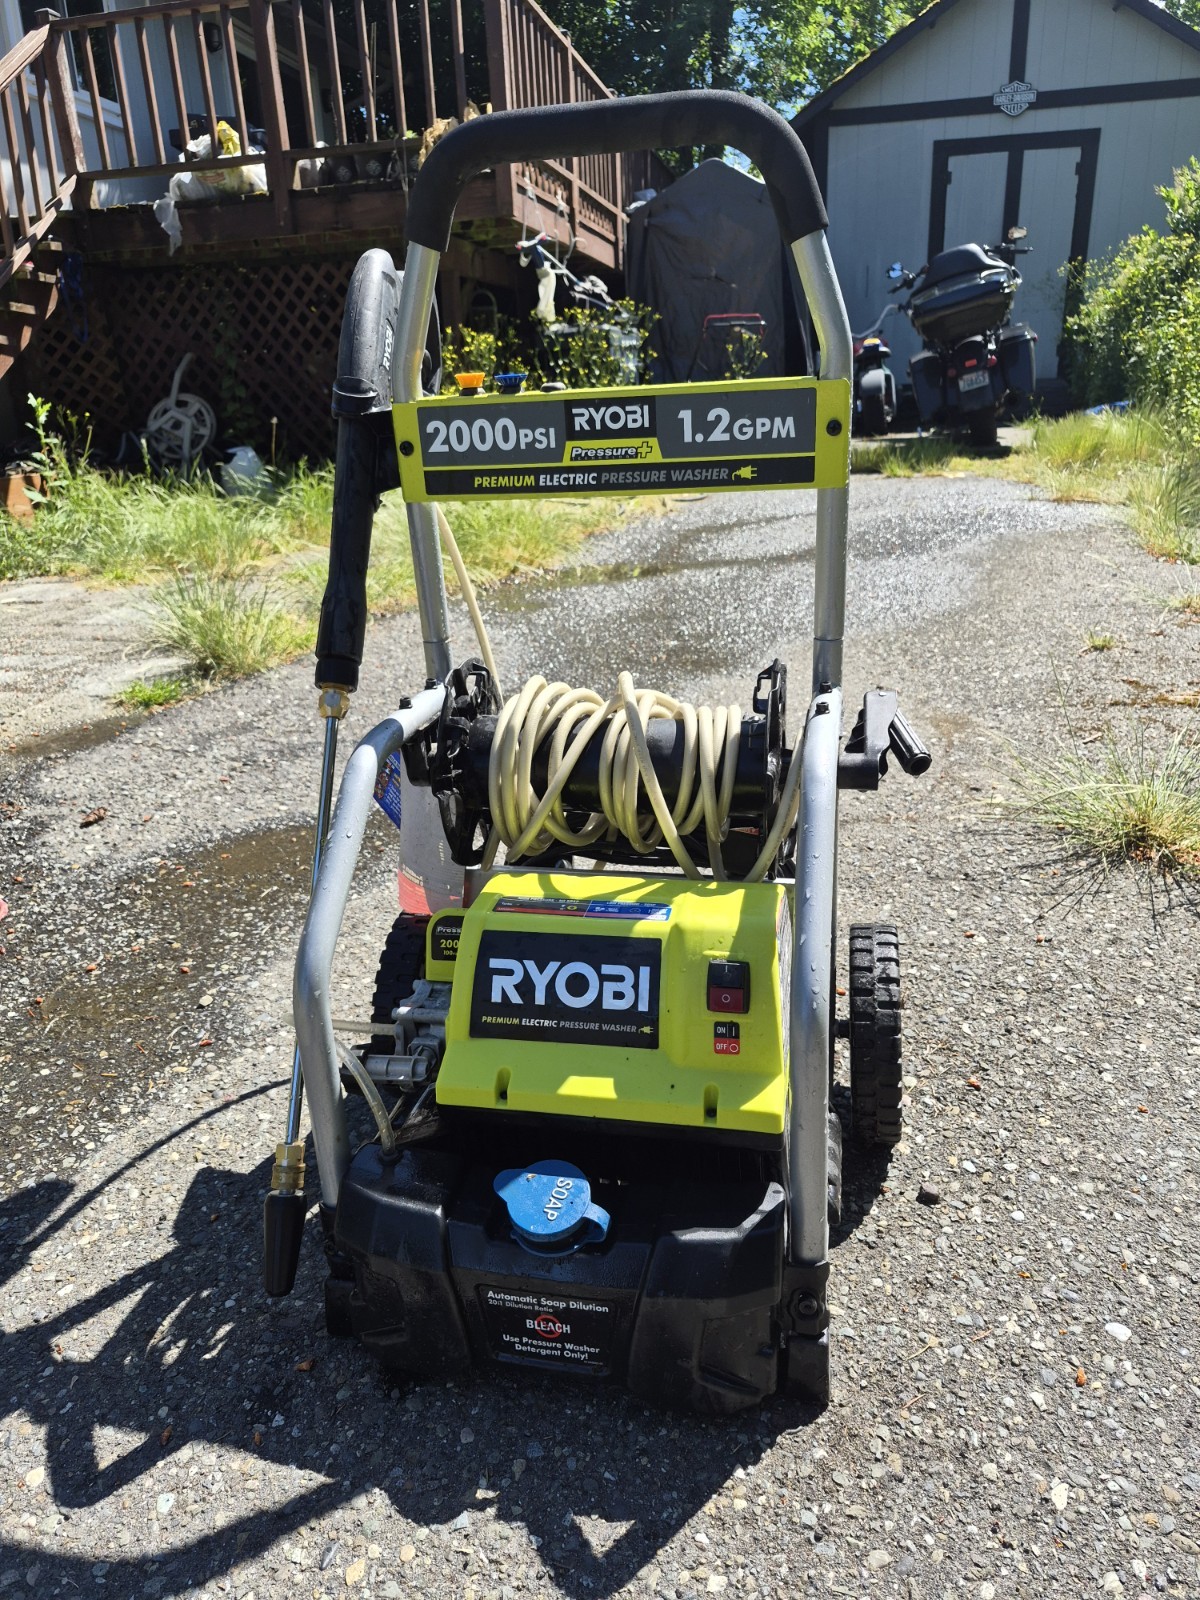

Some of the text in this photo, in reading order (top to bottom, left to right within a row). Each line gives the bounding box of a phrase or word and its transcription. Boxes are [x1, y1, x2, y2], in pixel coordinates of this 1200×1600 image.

[382, 325, 393, 371] RYOBI
[572, 405, 649, 431] RYOBI
[474, 468, 729, 488] PREMIUM ELECTRIC PRESSURE WASHER
[489, 957, 651, 1012] RYOBI
[481, 1015, 637, 1033] PREMIUM ELECTRIC PRESSURE WASHER
[716, 1026, 726, 1034] ON
[543, 1177, 573, 1221] SOAP
[487, 1290, 609, 1313] Automatic Soap Dilution
[505, 1301, 532, 1310] Dilution
[534, 1305, 553, 1313] Ratio
[526, 1319, 571, 1334] BLEACH
[503, 1334, 600, 1354] Use Pressure Washer
[515, 1343, 589, 1361] Detergent Only!
